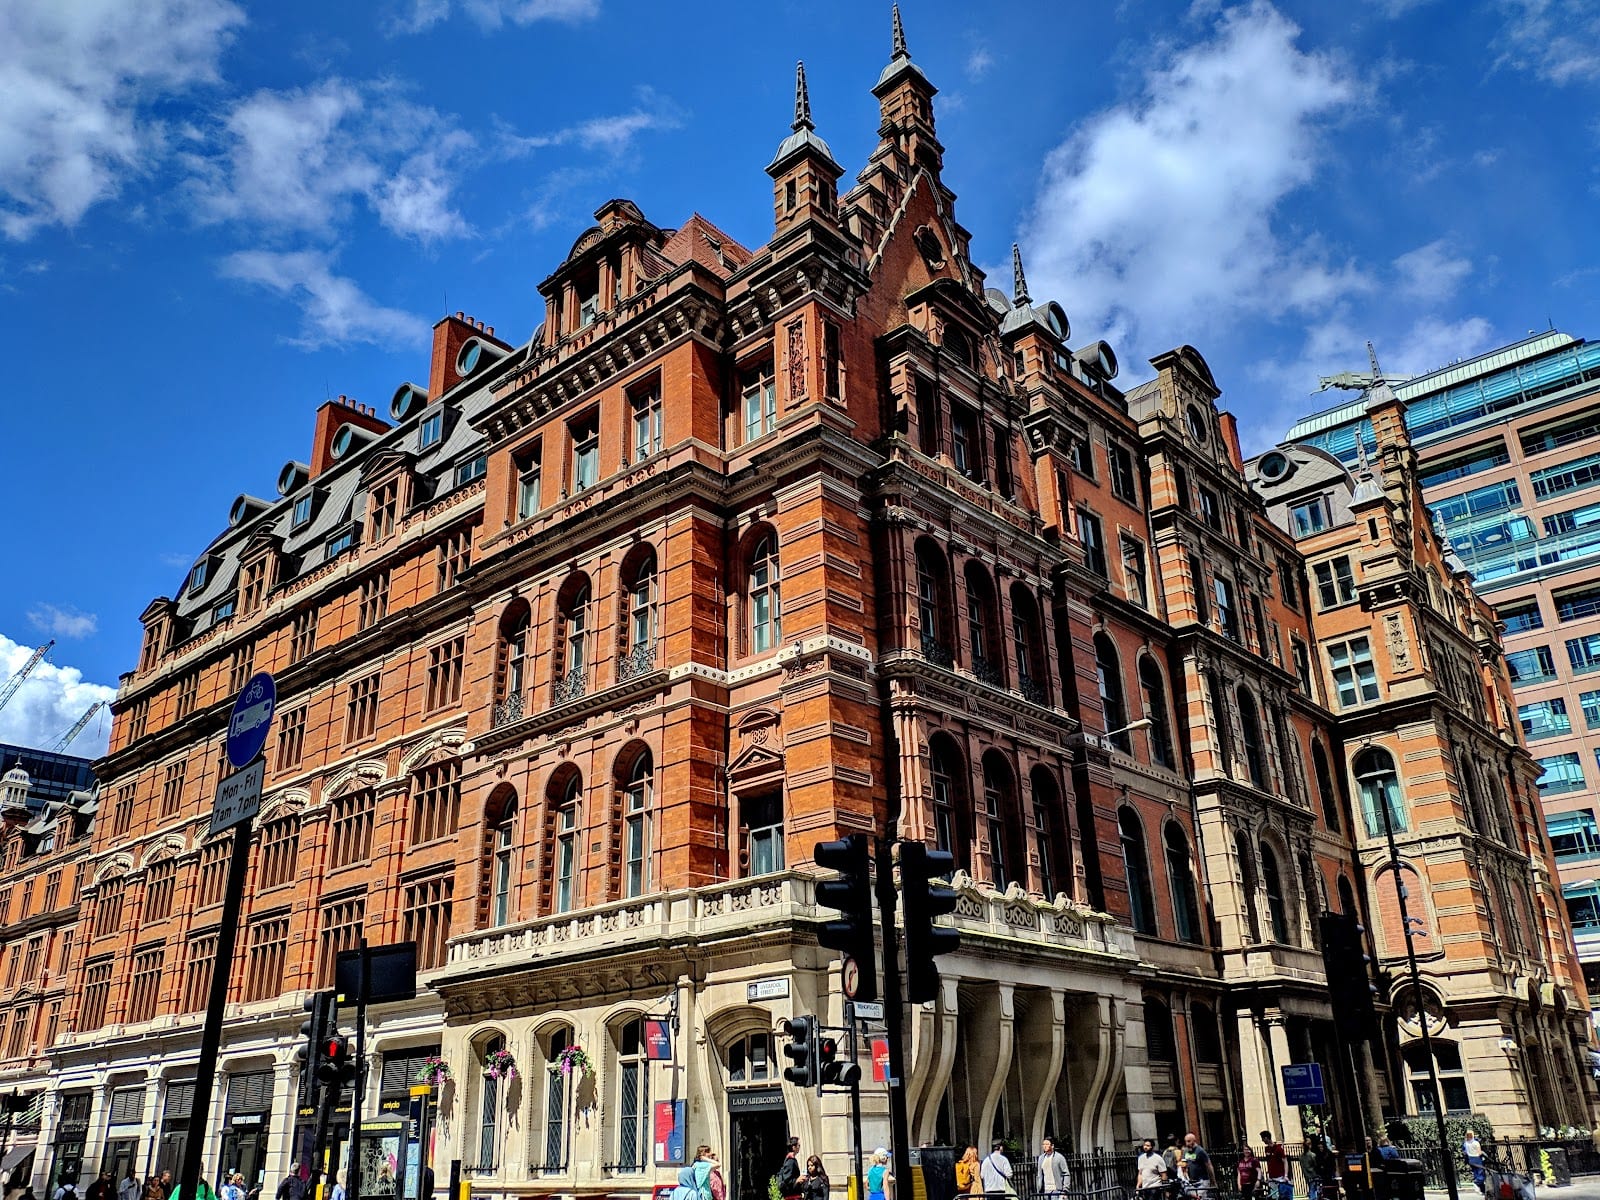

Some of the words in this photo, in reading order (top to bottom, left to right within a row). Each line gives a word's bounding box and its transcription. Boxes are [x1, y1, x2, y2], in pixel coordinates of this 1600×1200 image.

[221, 784, 238, 803] Mon
[244, 771, 257, 790] Fri
[214, 806, 232, 824] 7am
[238, 794, 257, 813] 7pm
[732, 1098, 748, 1106] LADY
